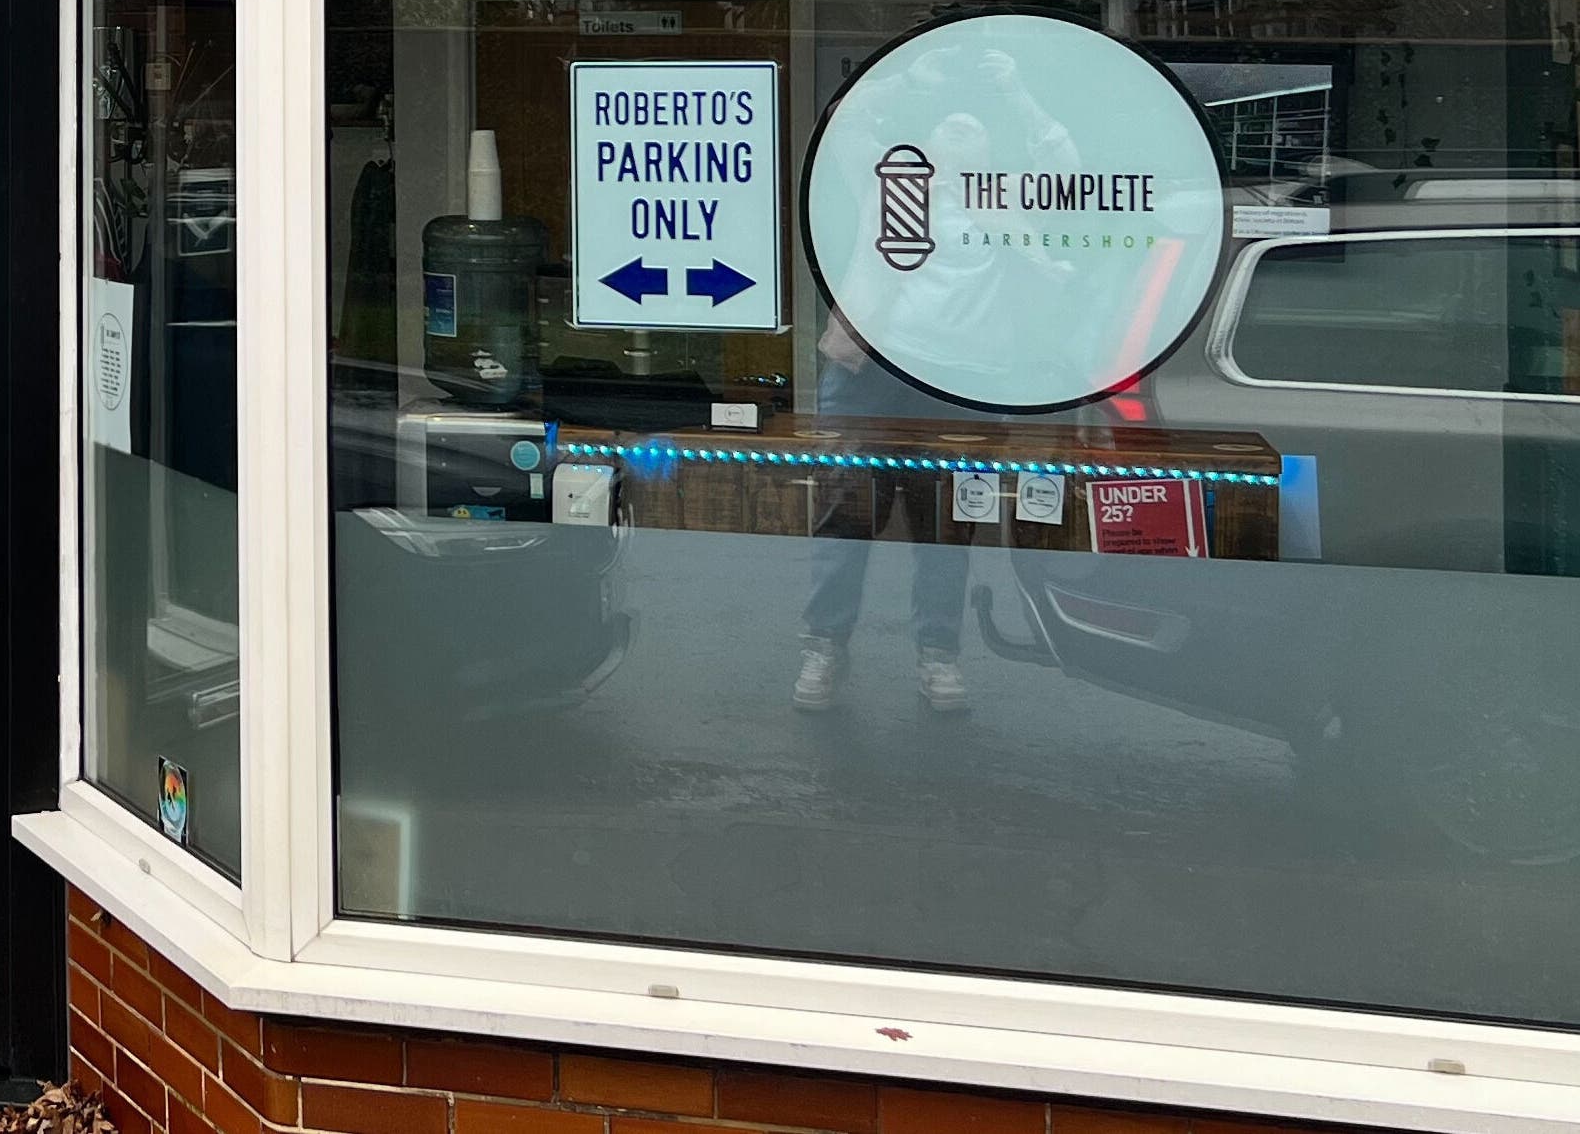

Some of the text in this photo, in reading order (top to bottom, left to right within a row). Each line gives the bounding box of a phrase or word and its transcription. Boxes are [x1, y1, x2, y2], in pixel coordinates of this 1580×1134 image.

[582, 19, 634, 34] Toilets
[594, 90, 753, 126] ROBERTO'S
[597, 141, 753, 184] PARKING
[960, 172, 1154, 212] THE COMPLETE
[631, 197, 719, 241] ONLY
[962, 232, 1155, 249] BARBERSHOP
[1099, 485, 1168, 505] UNDER
[1100, 505, 1134, 523] 25?
